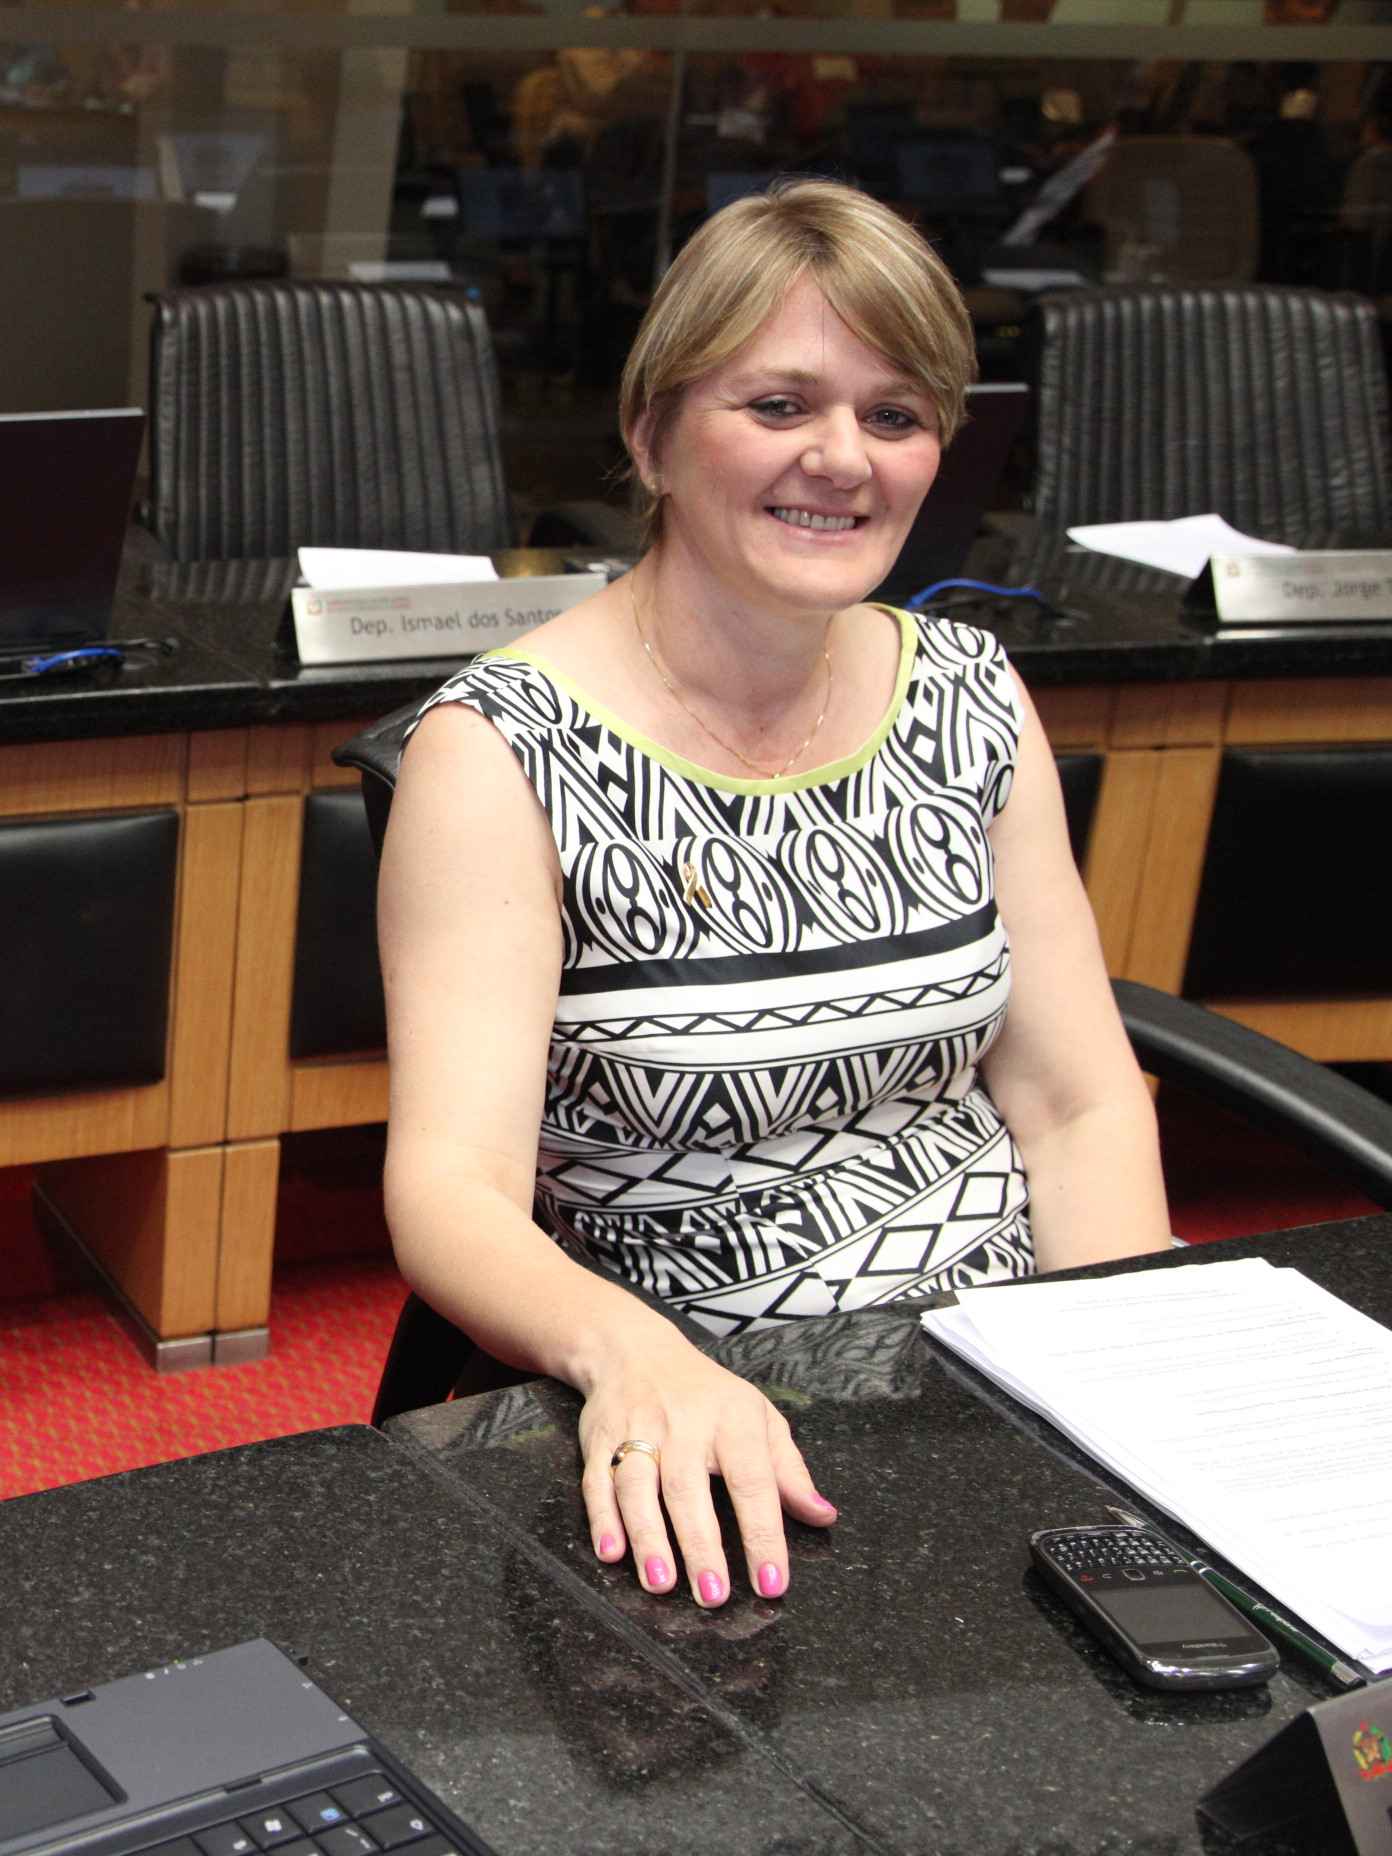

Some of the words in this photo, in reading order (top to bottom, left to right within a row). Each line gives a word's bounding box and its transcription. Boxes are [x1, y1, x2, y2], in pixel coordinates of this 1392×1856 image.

[350, 616, 394, 637] Dep.
[401, 611, 461, 634] Ismael
[467, 611, 500, 629] dos
